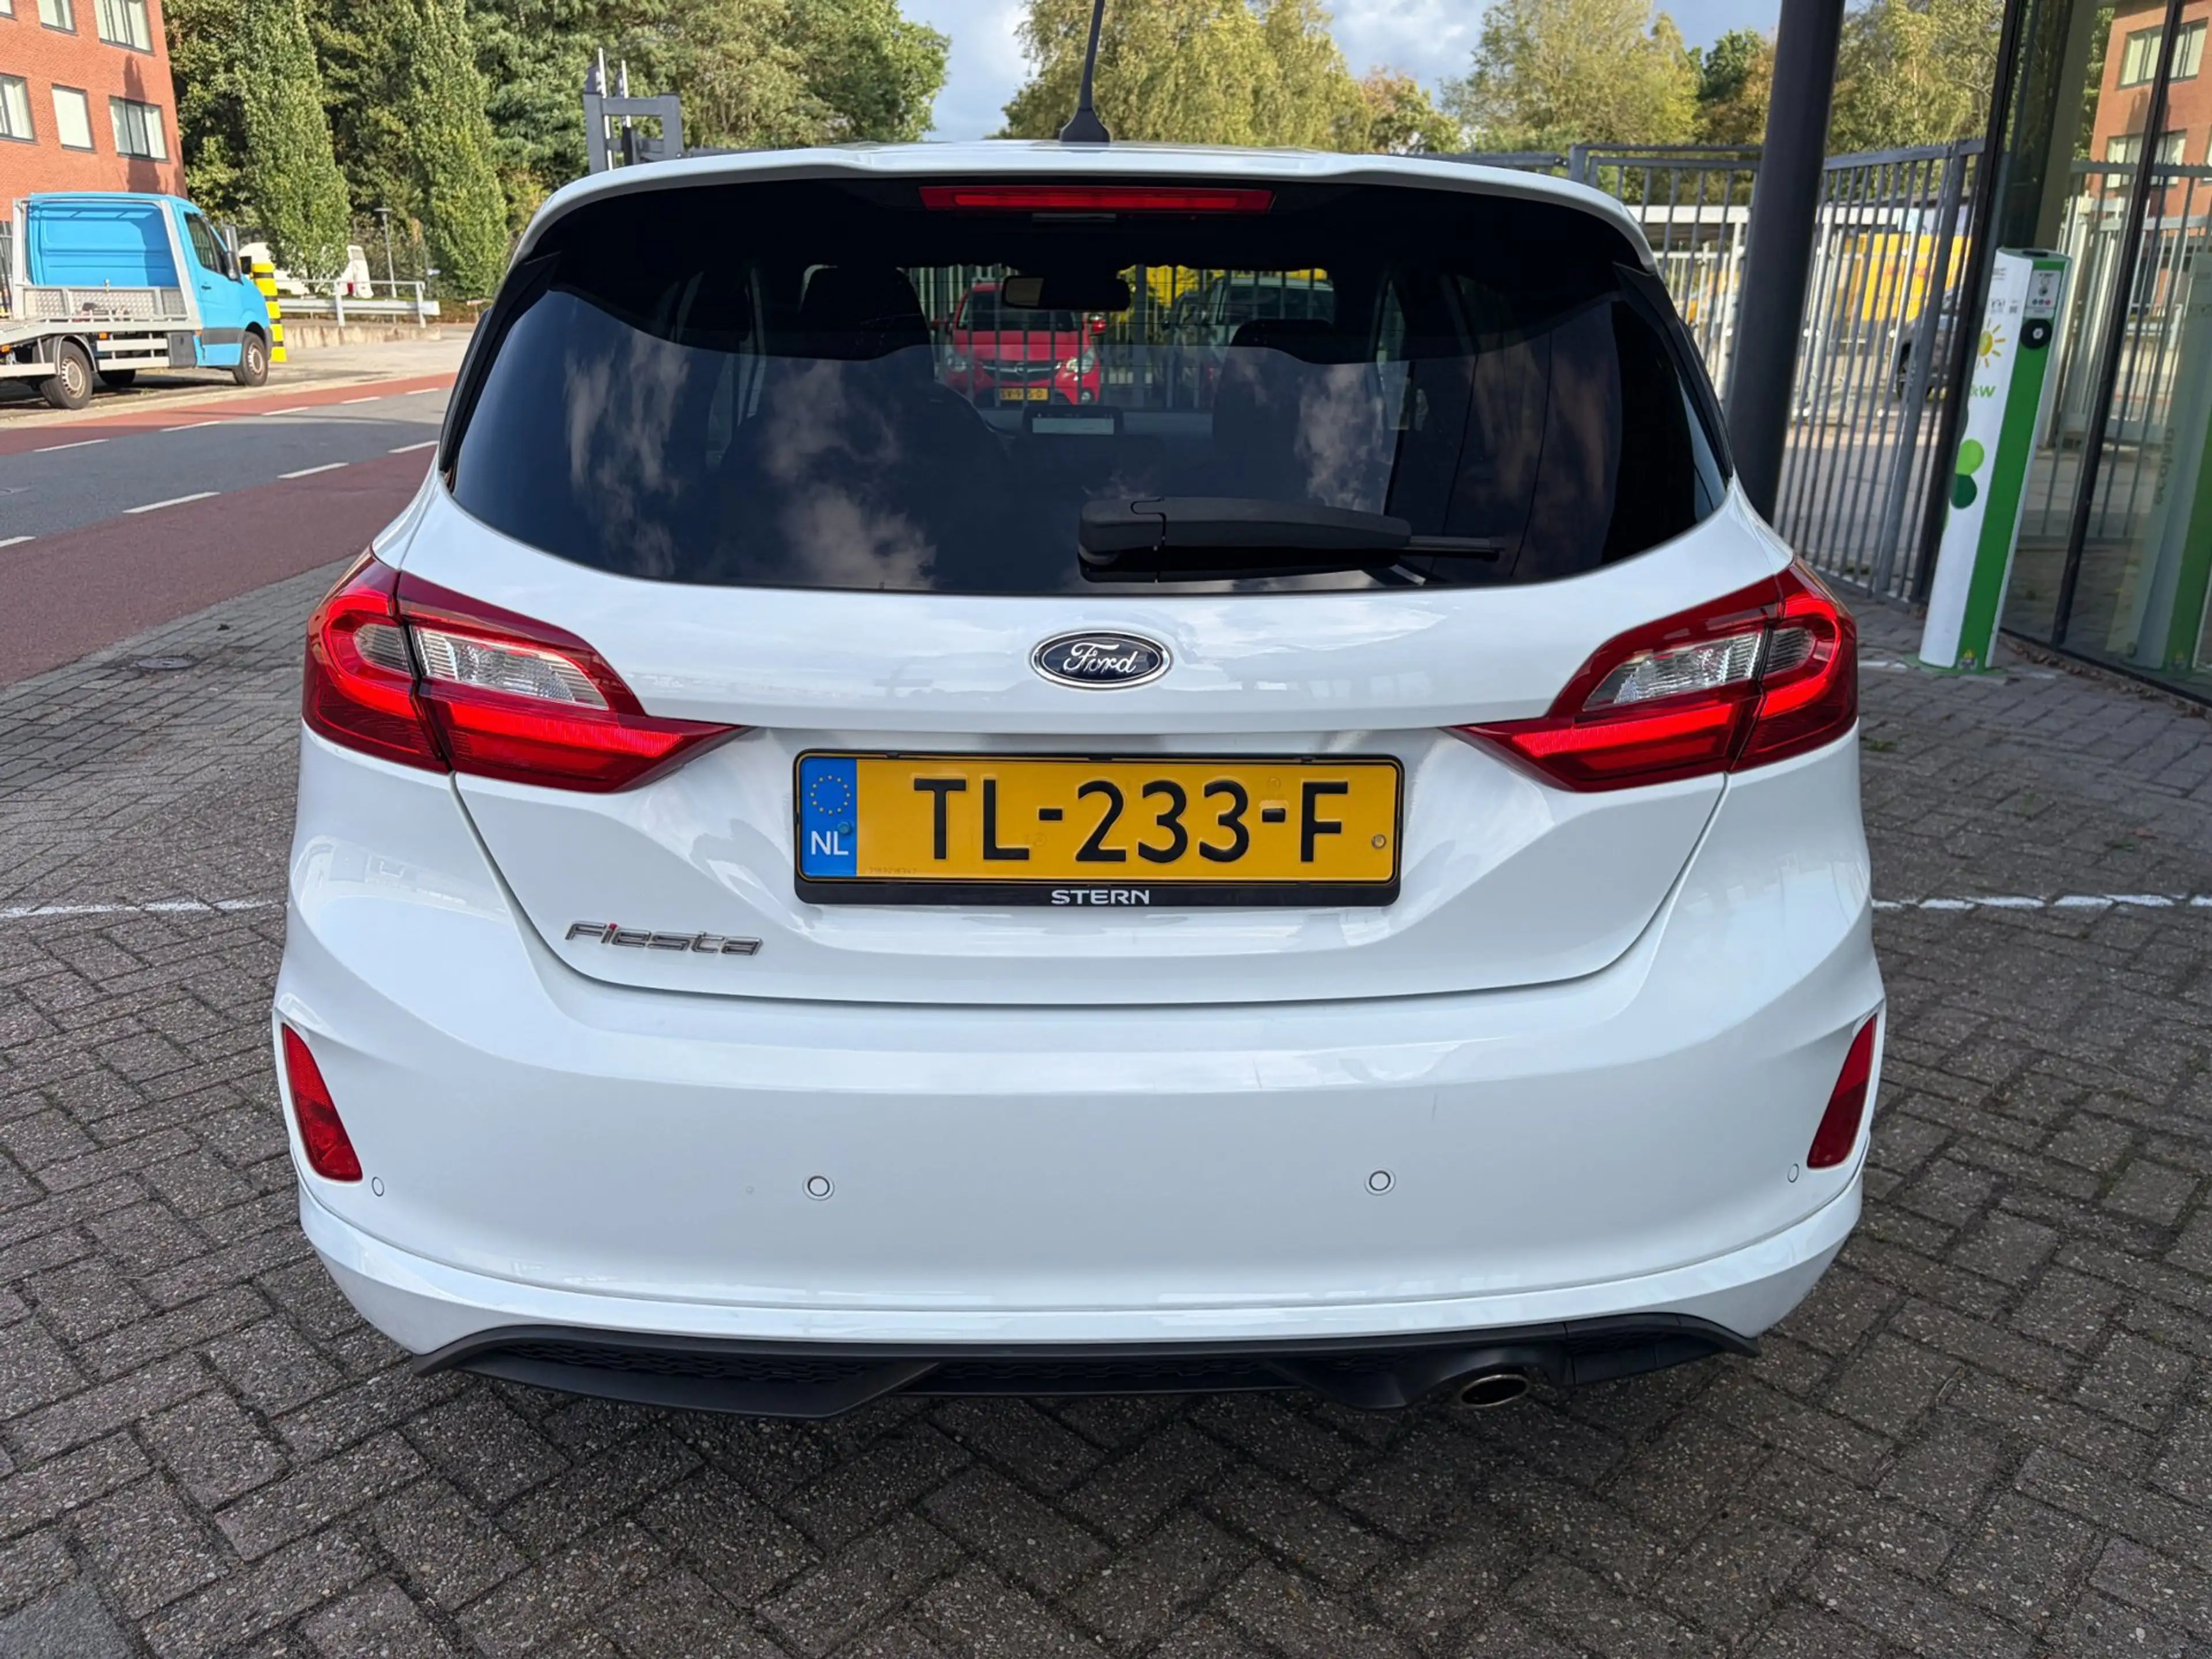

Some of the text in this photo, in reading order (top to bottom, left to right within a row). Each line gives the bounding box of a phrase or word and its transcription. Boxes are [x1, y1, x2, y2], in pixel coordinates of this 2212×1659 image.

[1063, 642, 1139, 673] Ford
[913, 778, 1349, 864] TL-233-F
[811, 831, 849, 856] NL
[1051, 889, 1150, 905] STERN
[564, 920, 764, 957] Fiesta
